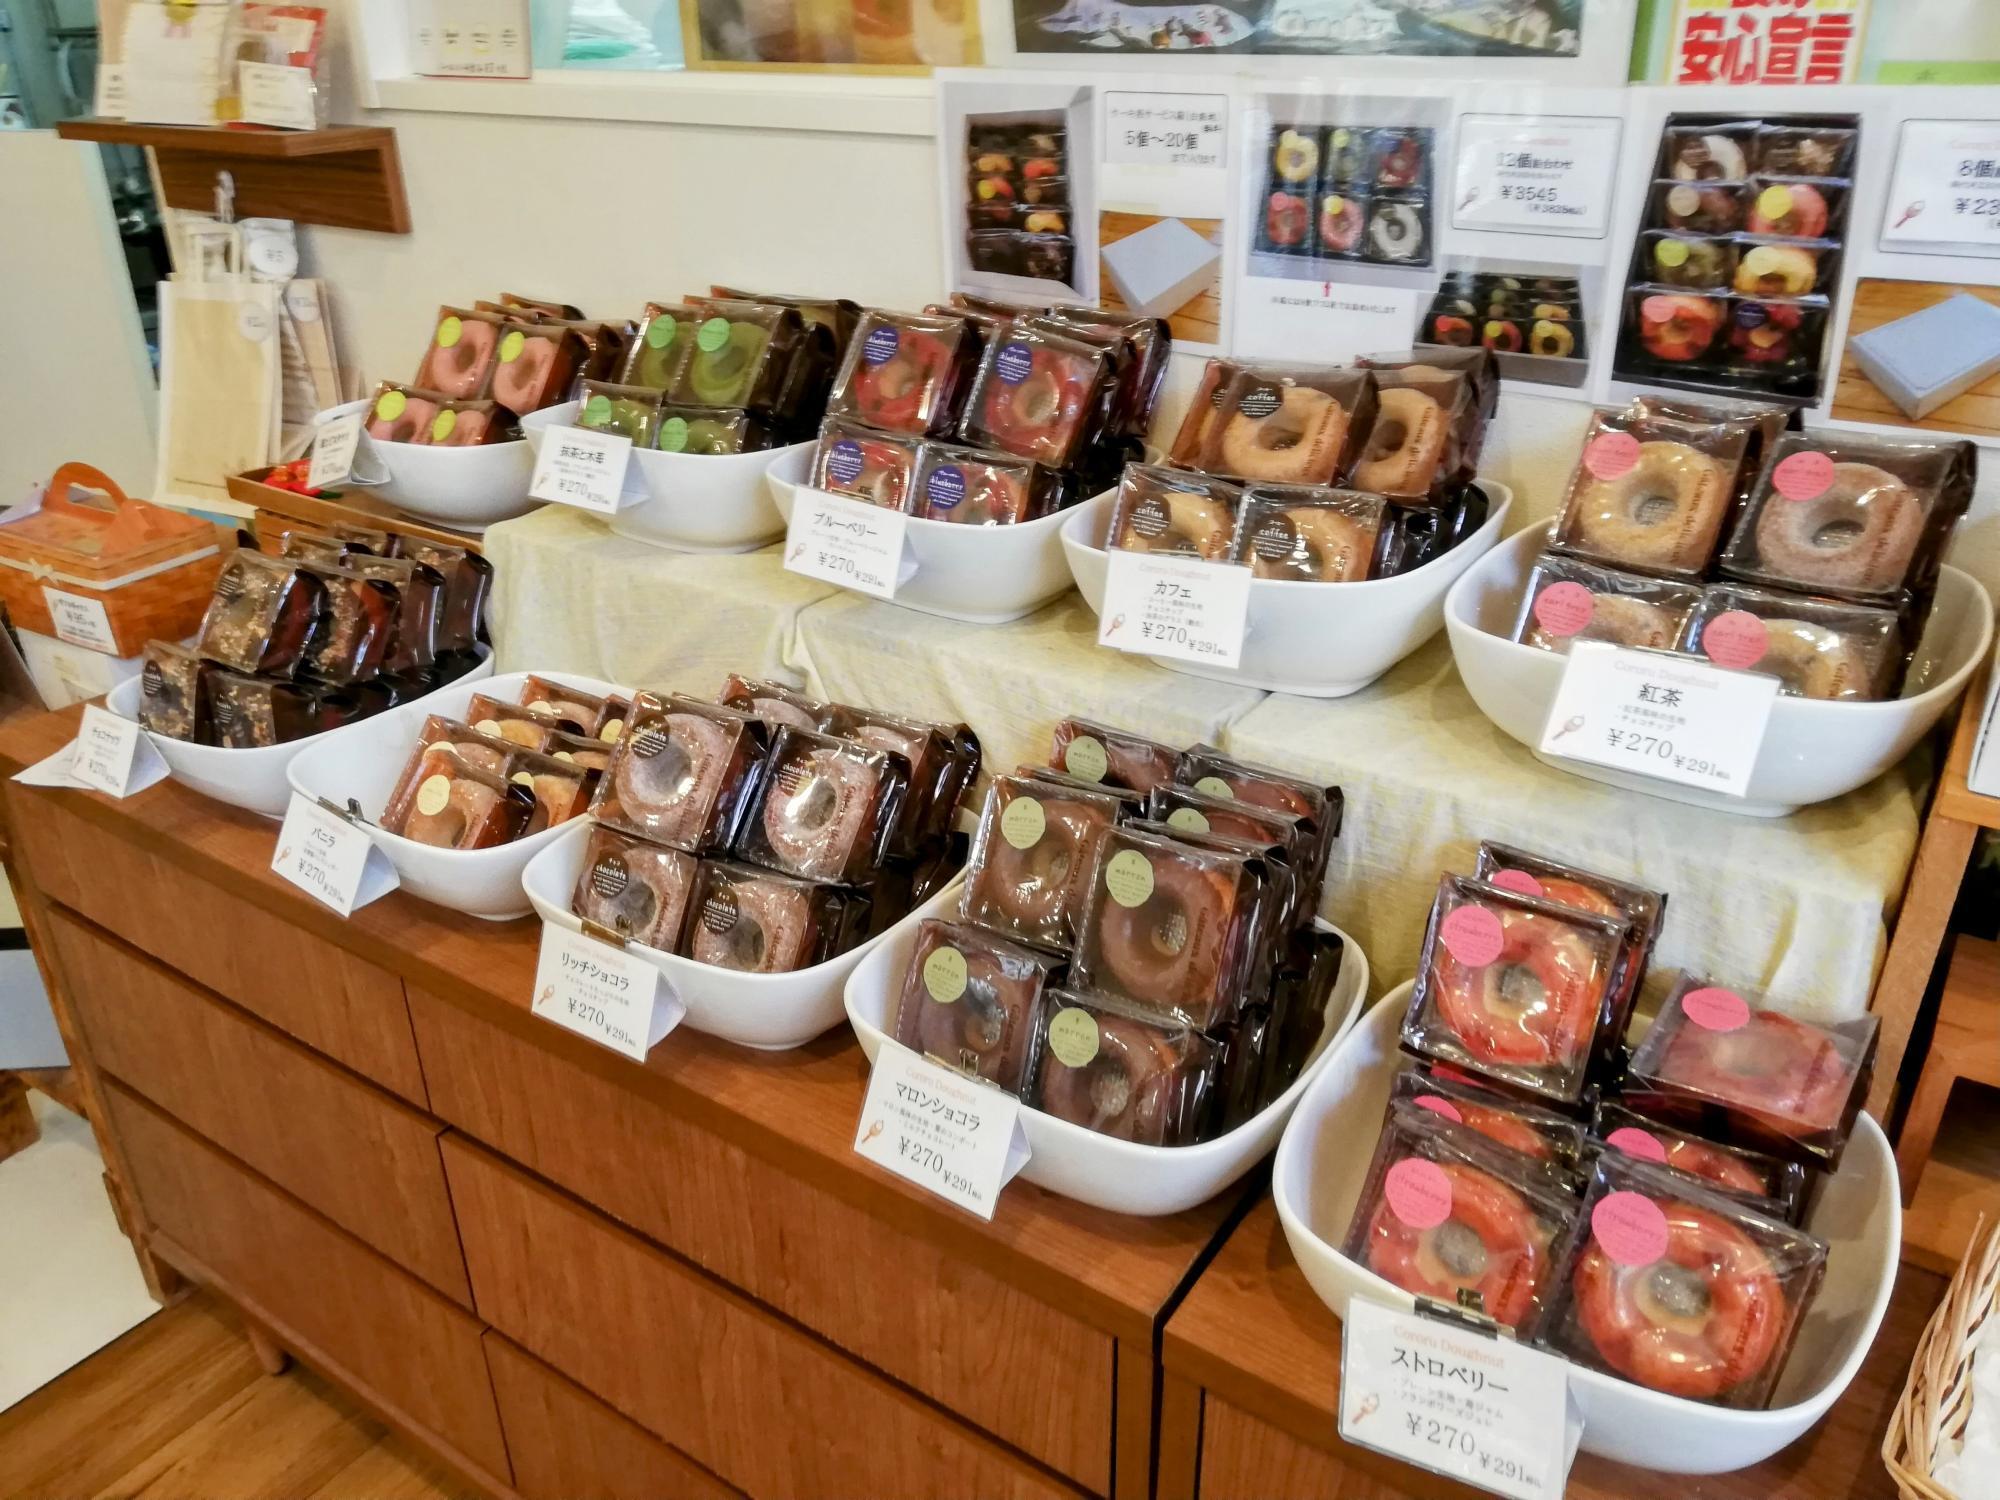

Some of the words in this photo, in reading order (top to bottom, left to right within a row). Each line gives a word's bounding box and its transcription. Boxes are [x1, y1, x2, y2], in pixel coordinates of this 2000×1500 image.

[1677, 11, 1855, 85] 安心宣言
[1501, 184, 1558, 202] ¥3545
[1246, 391, 1277, 402] coffee
[813, 512, 879, 537] ブルーベリー
[1136, 506, 1165, 518] coffee
[1258, 526, 1290, 540] coffee
[818, 551, 856, 575] ¥270
[1154, 579, 1193, 599] カフェ
[1142, 621, 1189, 645] ¥270
[1637, 682, 1684, 709] 紅茶
[1607, 727, 1674, 760] ¥270
[311, 827, 337, 849] バニラ
[298, 857, 326, 885] ¥270
[560, 951, 631, 992] リッチショコラ
[567, 996, 605, 1027] ¥270
[895, 1081, 981, 1133] マロンショコラ
[898, 1135, 944, 1174] ¥270
[1390, 1347, 1510, 1394] ストロベリー
[1406, 1411, 1476, 1457] ¥270
